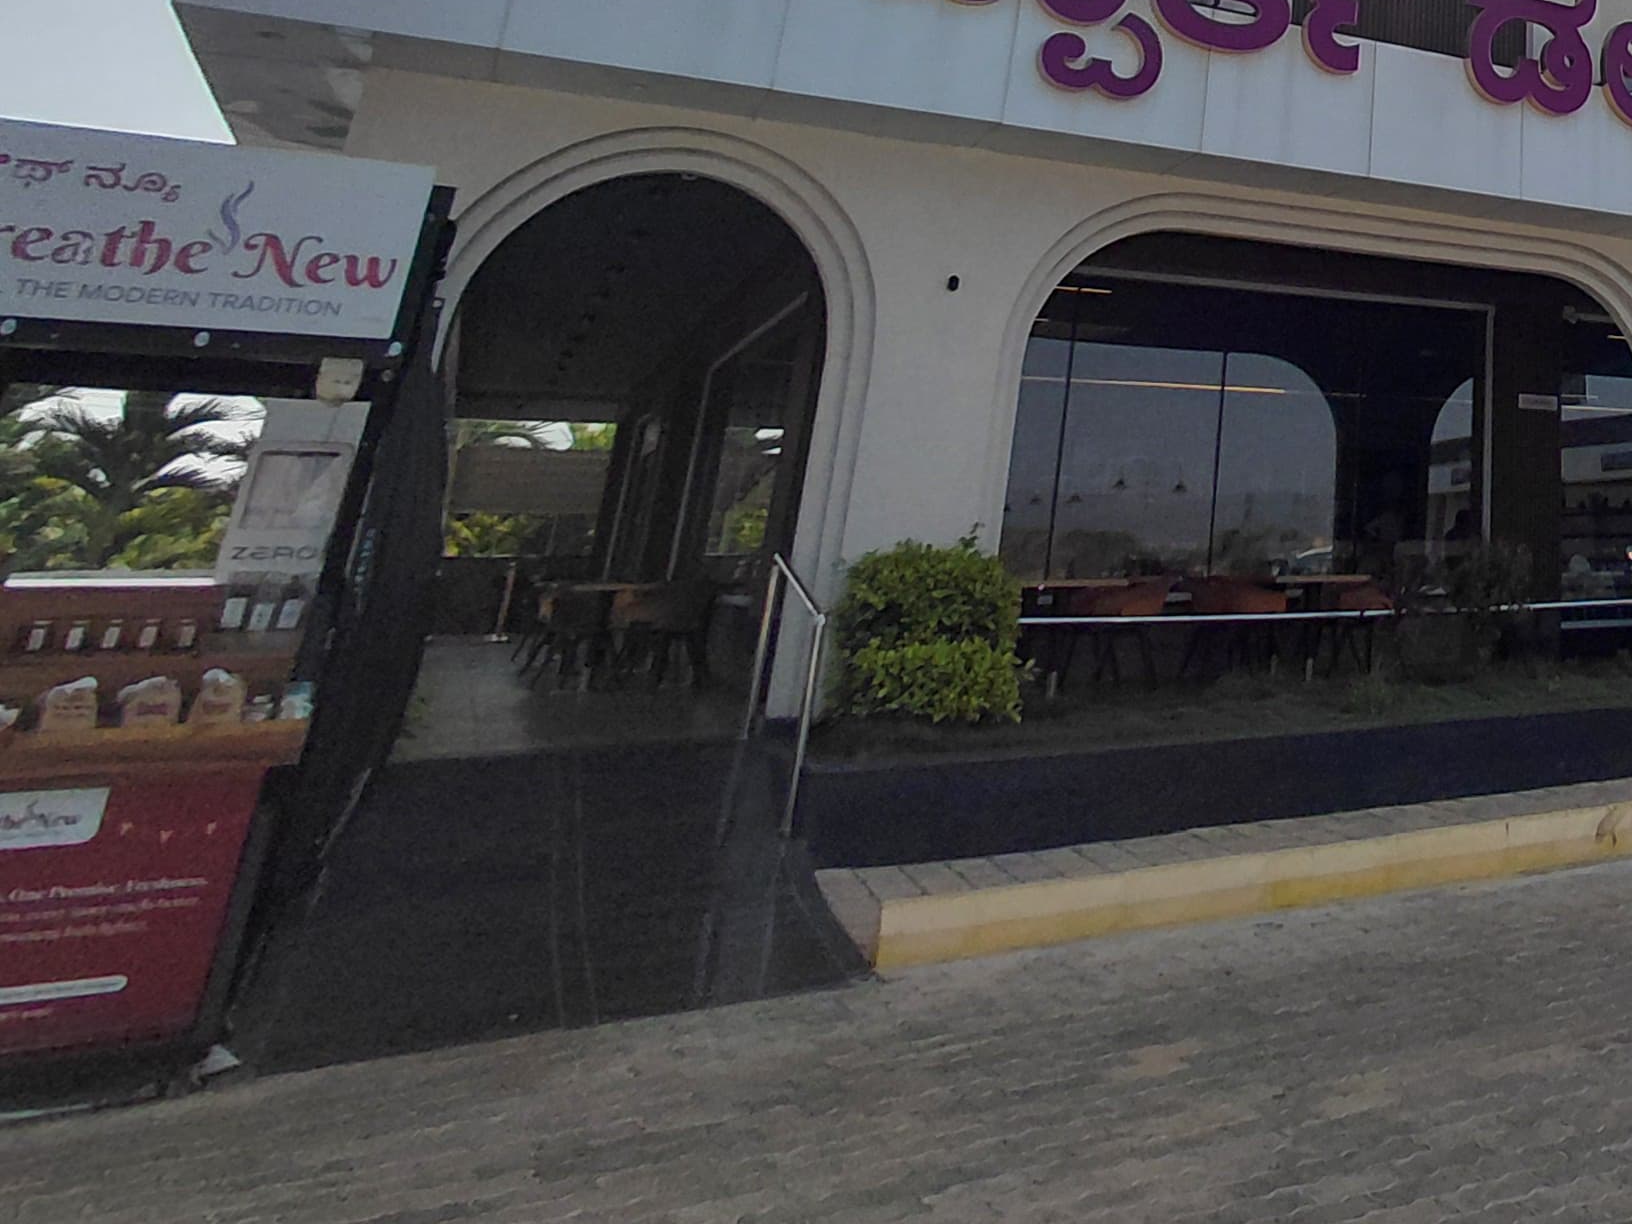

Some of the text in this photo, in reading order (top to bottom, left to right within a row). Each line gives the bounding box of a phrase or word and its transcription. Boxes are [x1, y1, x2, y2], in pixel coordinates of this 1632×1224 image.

[233, 232, 398, 289] New
[16, 278, 344, 317] THE MODERN TRADITION
[231, 545, 318, 561] ZERO
